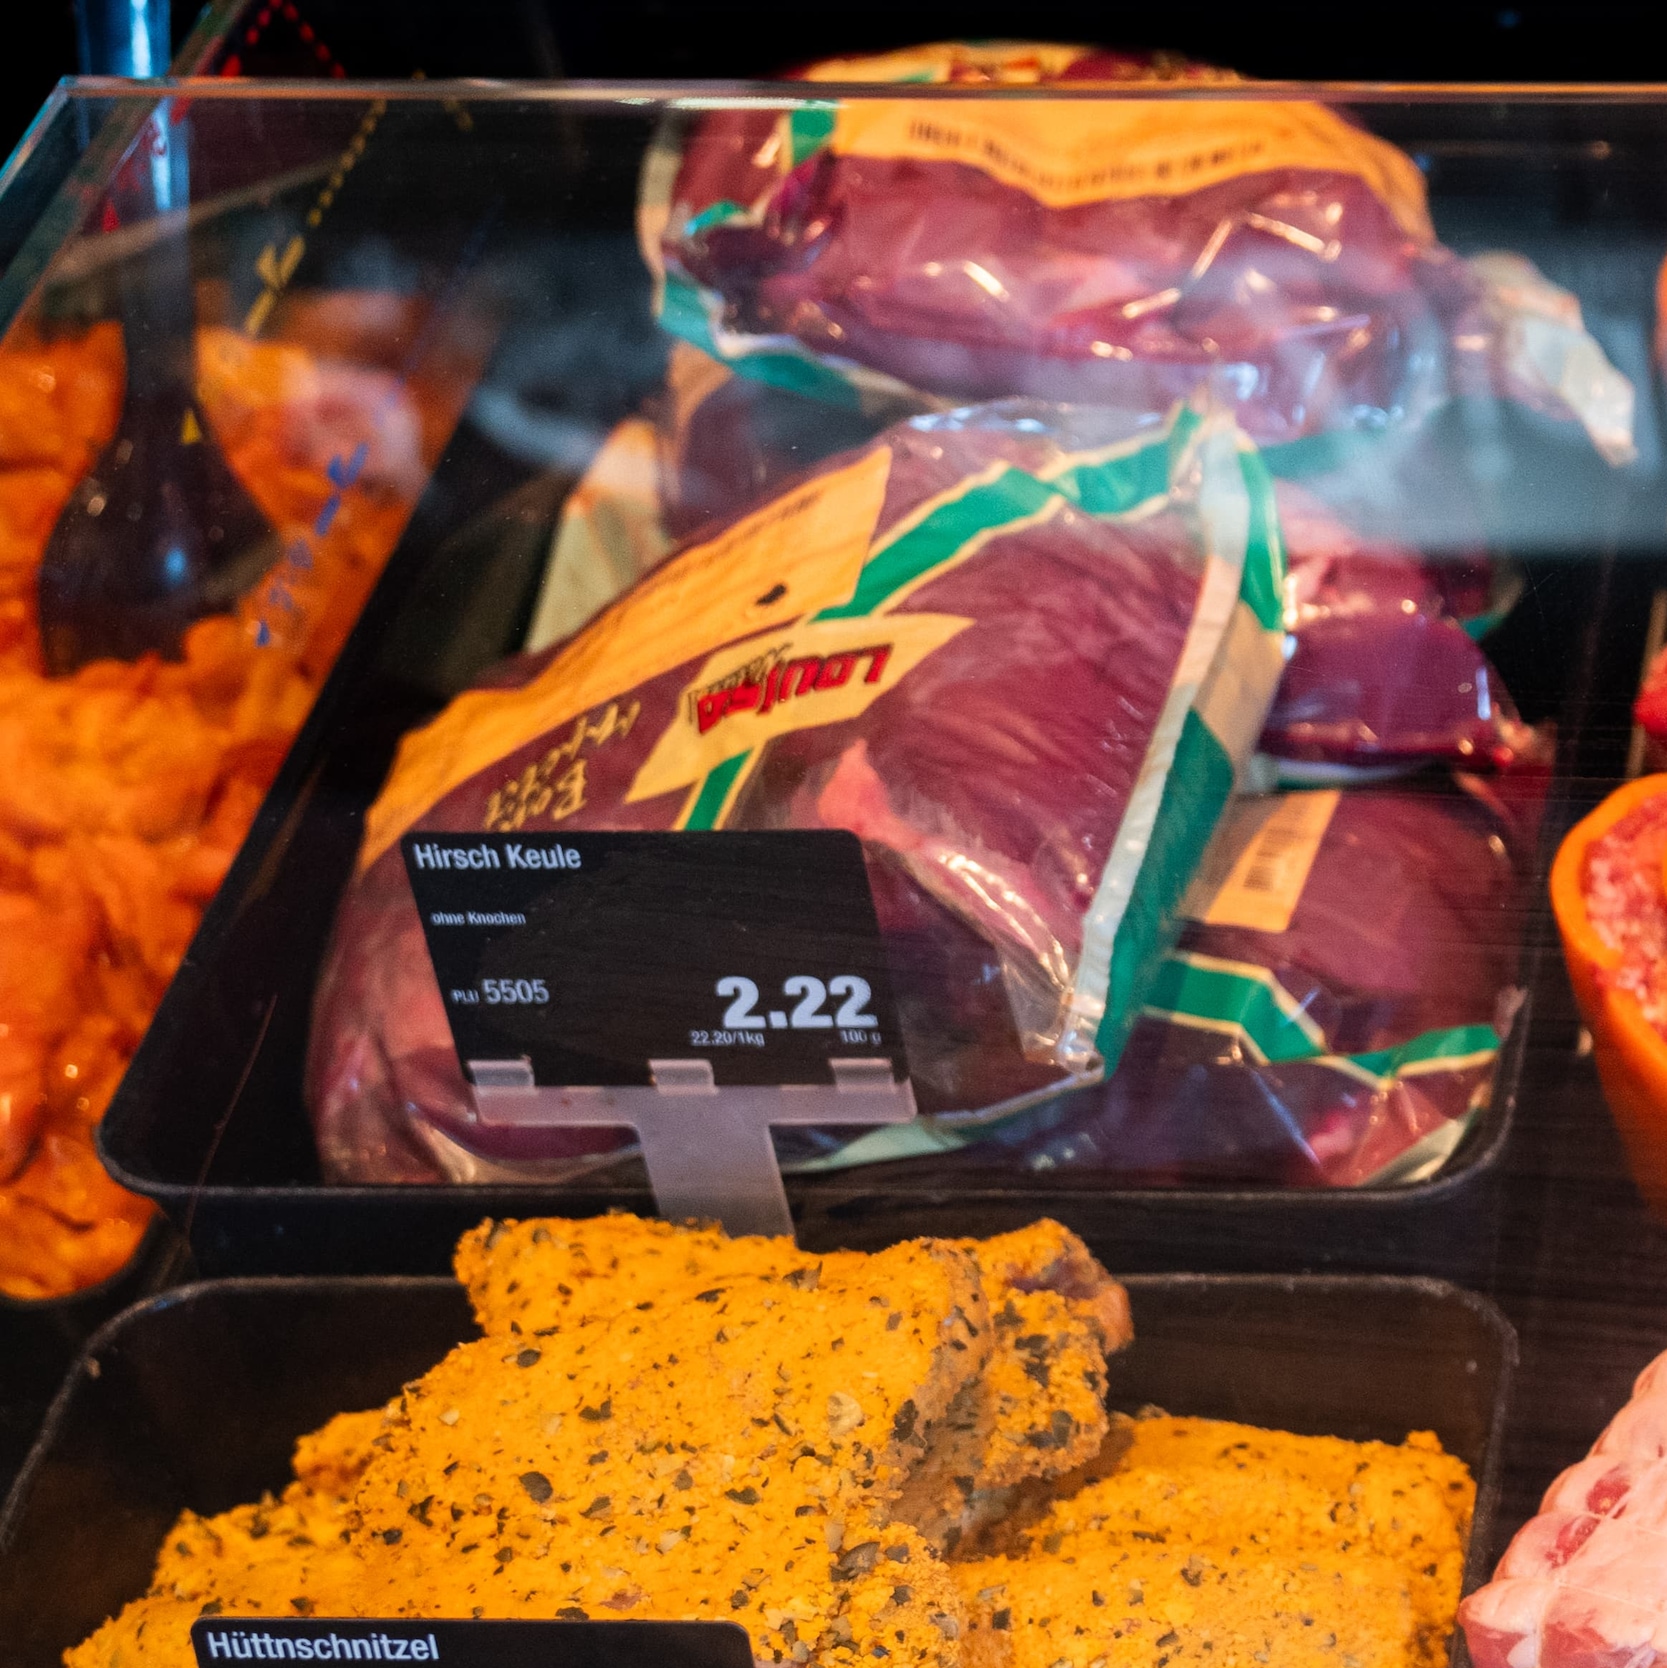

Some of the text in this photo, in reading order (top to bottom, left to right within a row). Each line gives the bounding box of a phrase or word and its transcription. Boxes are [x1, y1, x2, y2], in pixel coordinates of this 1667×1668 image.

[414, 843, 582, 870] Hirsch Keule
[430, 910, 526, 925] ohne Knochen
[482, 978, 549, 1004] 5505
[716, 975, 878, 1030] 2.22
[690, 1029, 765, 1047] 22.20/1kg
[840, 1030, 868, 1045] 100
[207, 1632, 440, 1661] Hüttnschnitzel
